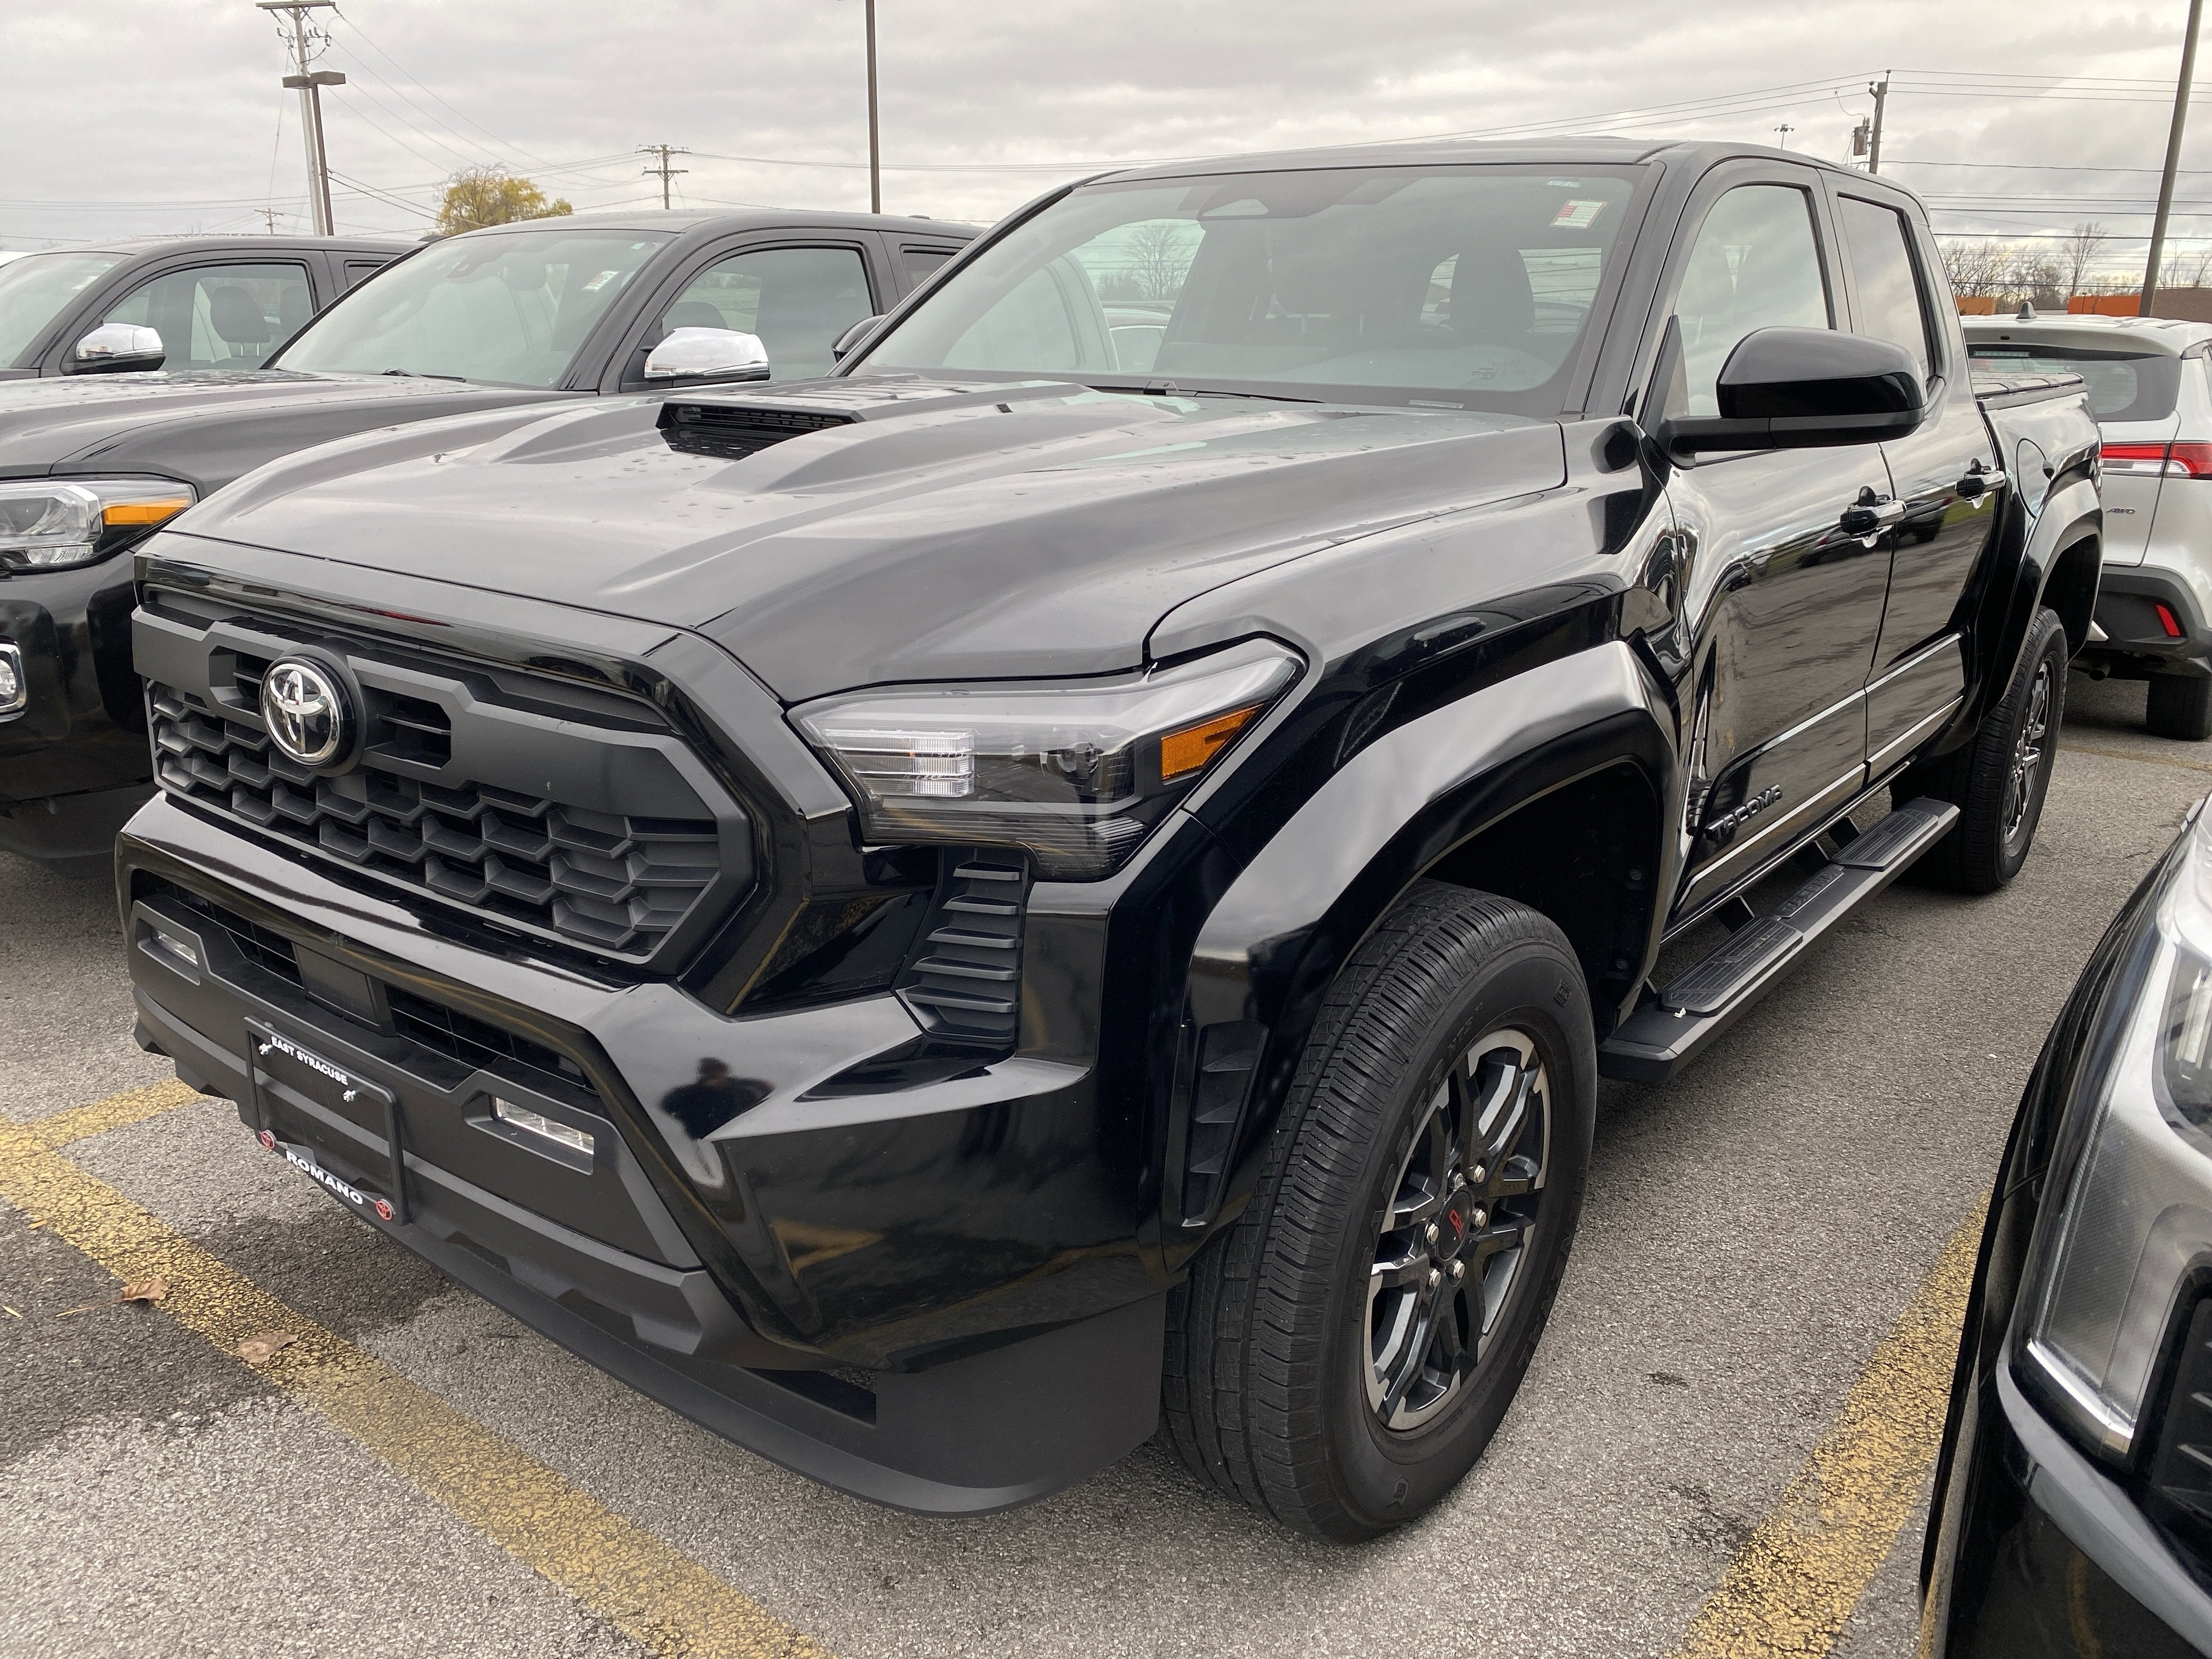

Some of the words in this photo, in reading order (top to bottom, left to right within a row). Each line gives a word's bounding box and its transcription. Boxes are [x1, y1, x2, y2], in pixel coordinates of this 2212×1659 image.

[1704, 785, 1783, 841] TACOMA
[271, 1036, 295, 1058] EAST
[296, 1049, 348, 1086] SYRACUSE
[286, 1150, 363, 1205] ROMANO
